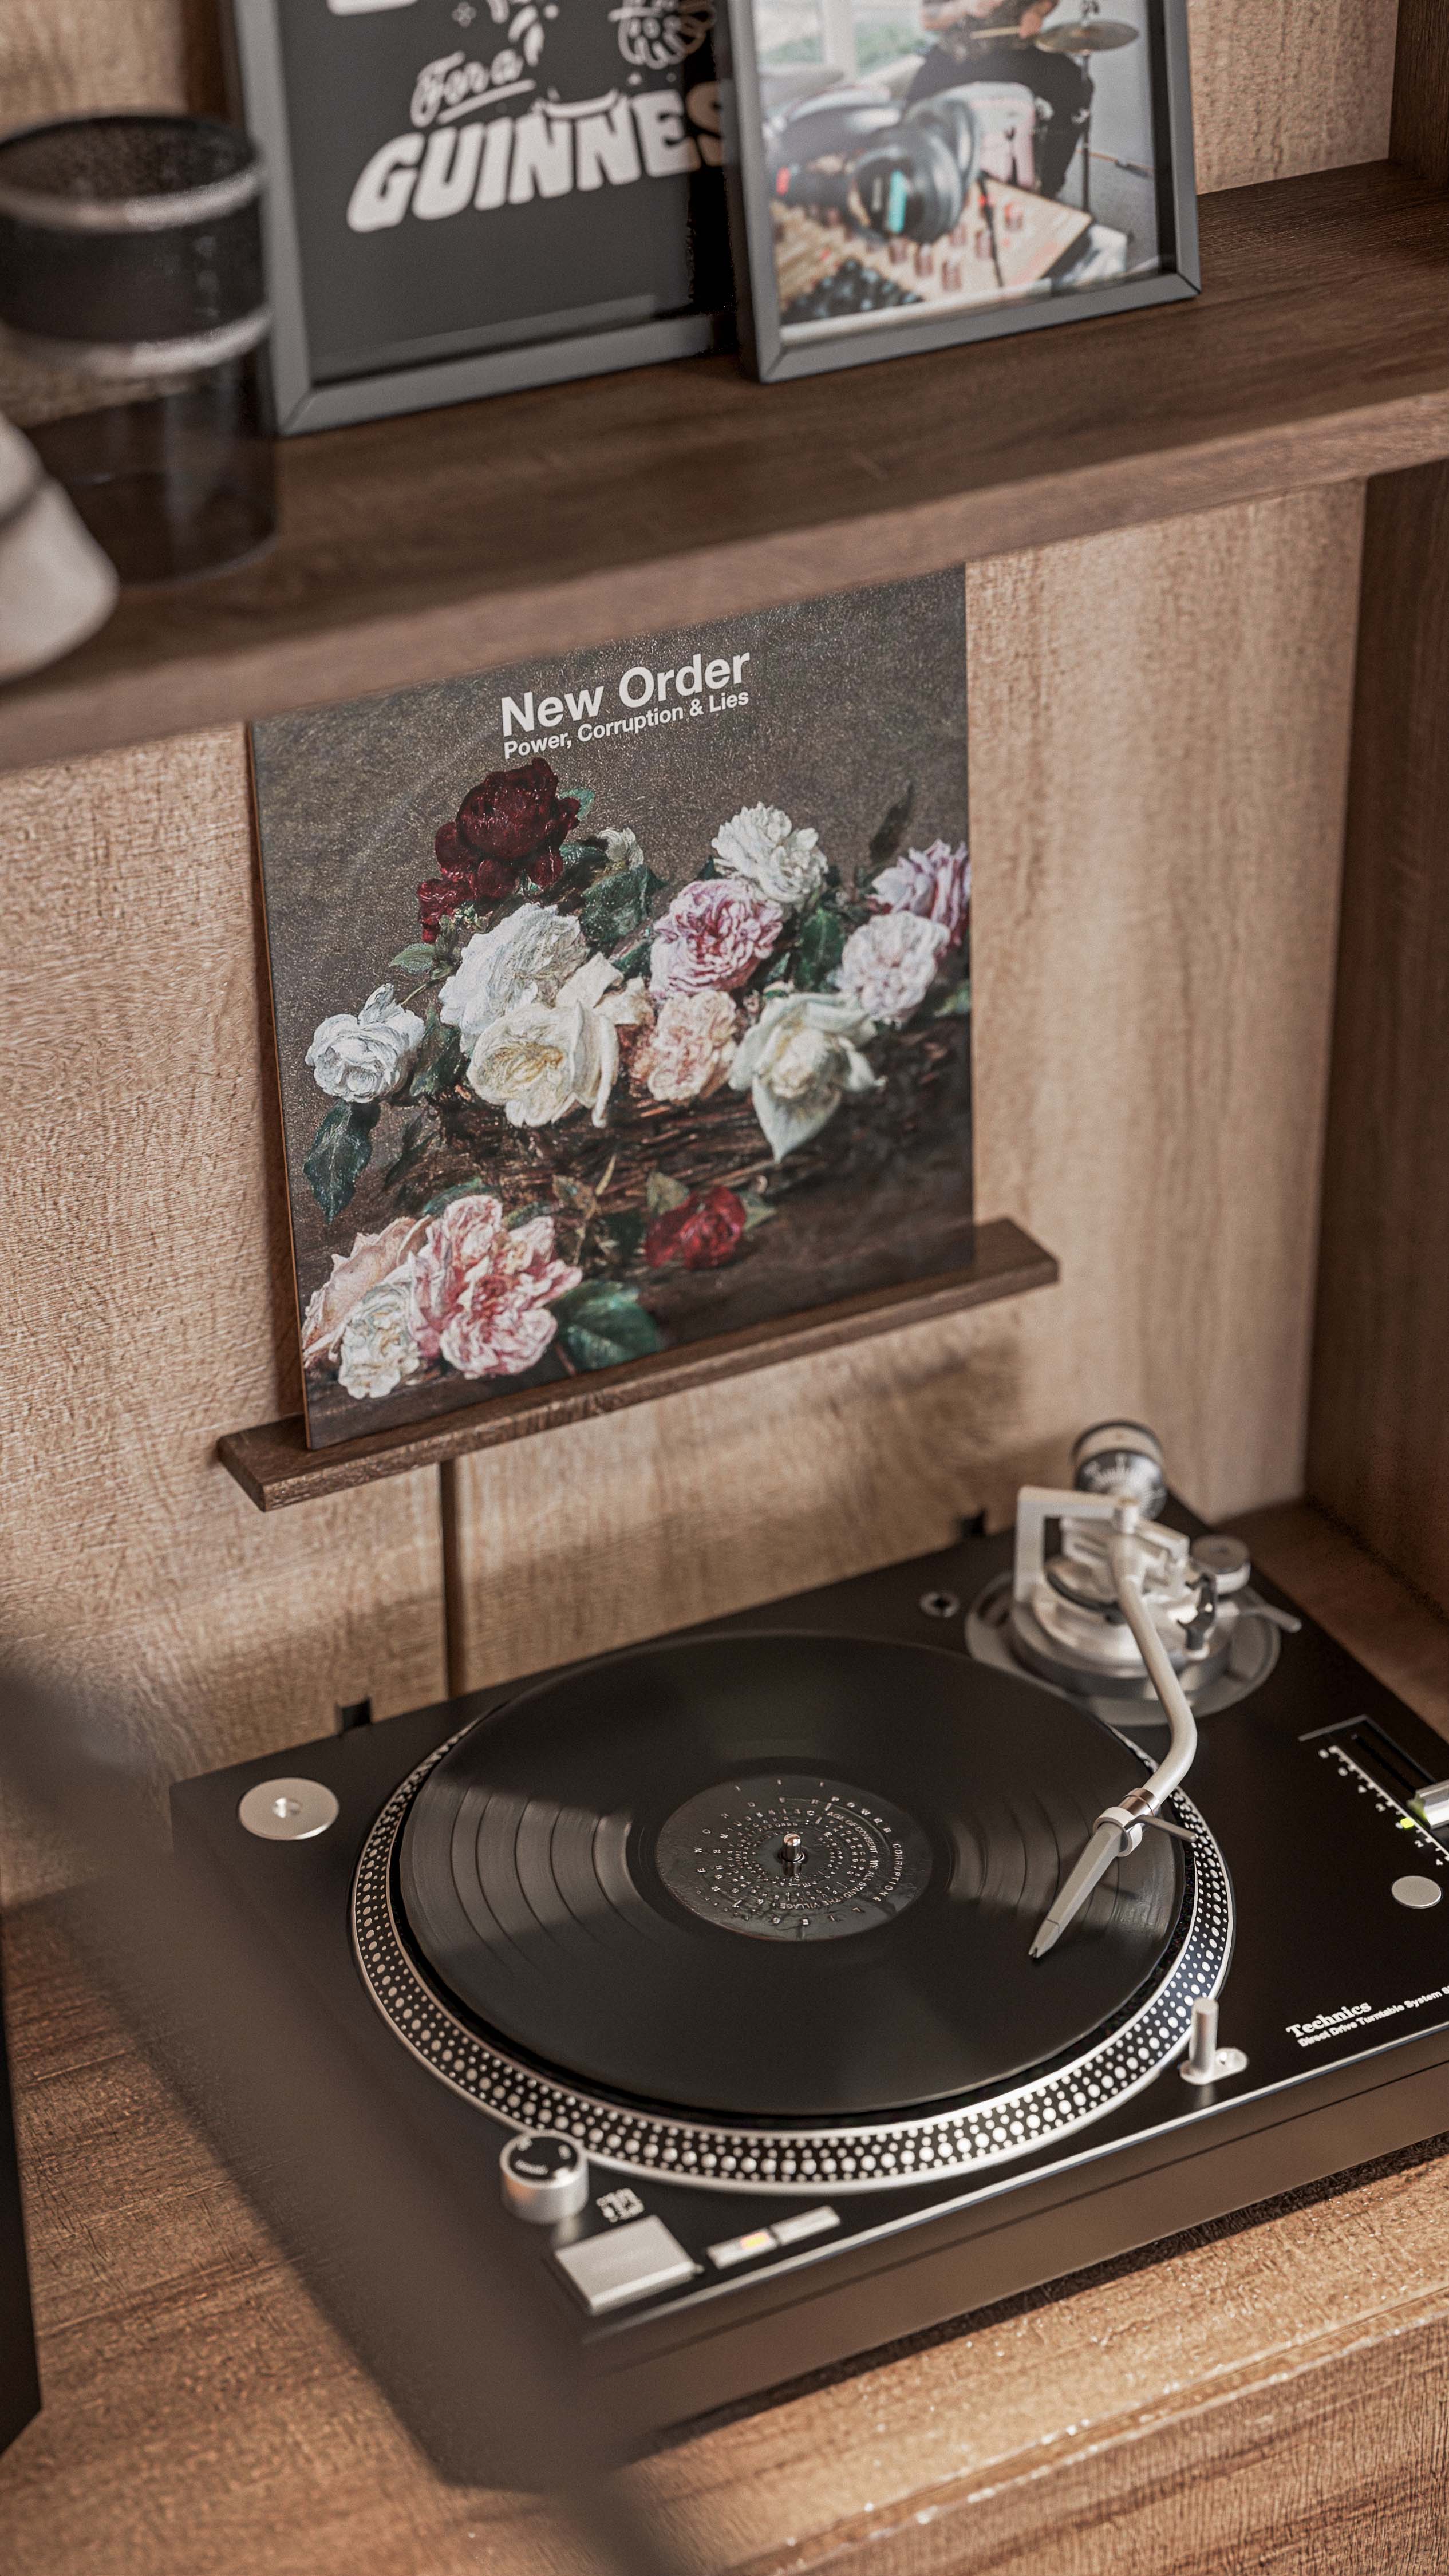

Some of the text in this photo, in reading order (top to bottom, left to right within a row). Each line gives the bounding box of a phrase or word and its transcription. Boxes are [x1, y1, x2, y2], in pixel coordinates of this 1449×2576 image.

[501, 652, 750, 737] New Order
[504, 692, 749, 759] Power, Corruption & Lies
[855, 1826, 879, 1854] CONSENT
[863, 1870, 875, 1881] ALL
[870, 1860, 879, 1870] WE
[879, 1843, 903, 1897] CORRUPTION
[843, 1882, 867, 1898] STAND
[1285, 2002, 1372, 2038] Technics
[1297, 2030, 1331, 2047] Direct
[1329, 2022, 1357, 2036] Drive
[1356, 2005, 1405, 2025] Turntable
[1404, 1991, 1443, 2008] System
